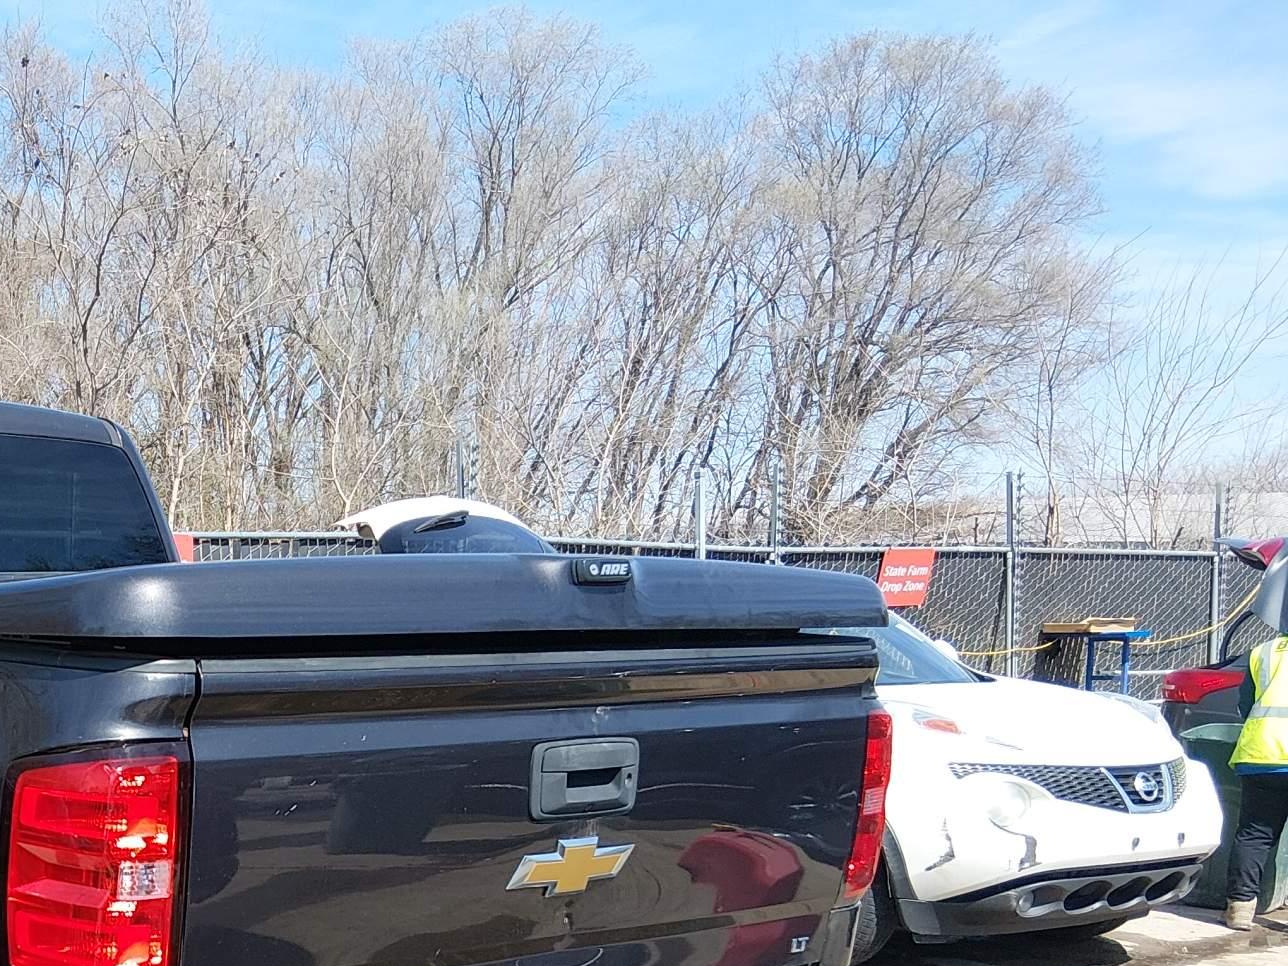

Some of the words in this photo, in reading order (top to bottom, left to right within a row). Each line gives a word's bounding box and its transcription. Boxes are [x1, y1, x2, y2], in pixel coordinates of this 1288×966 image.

[600, 563, 629, 576] ARE
[883, 566, 907, 577] State
[907, 565, 929, 576] Farm
[881, 581, 903, 595] Drop
[903, 580, 925, 592] Zone
[791, 936, 809, 953] LT
